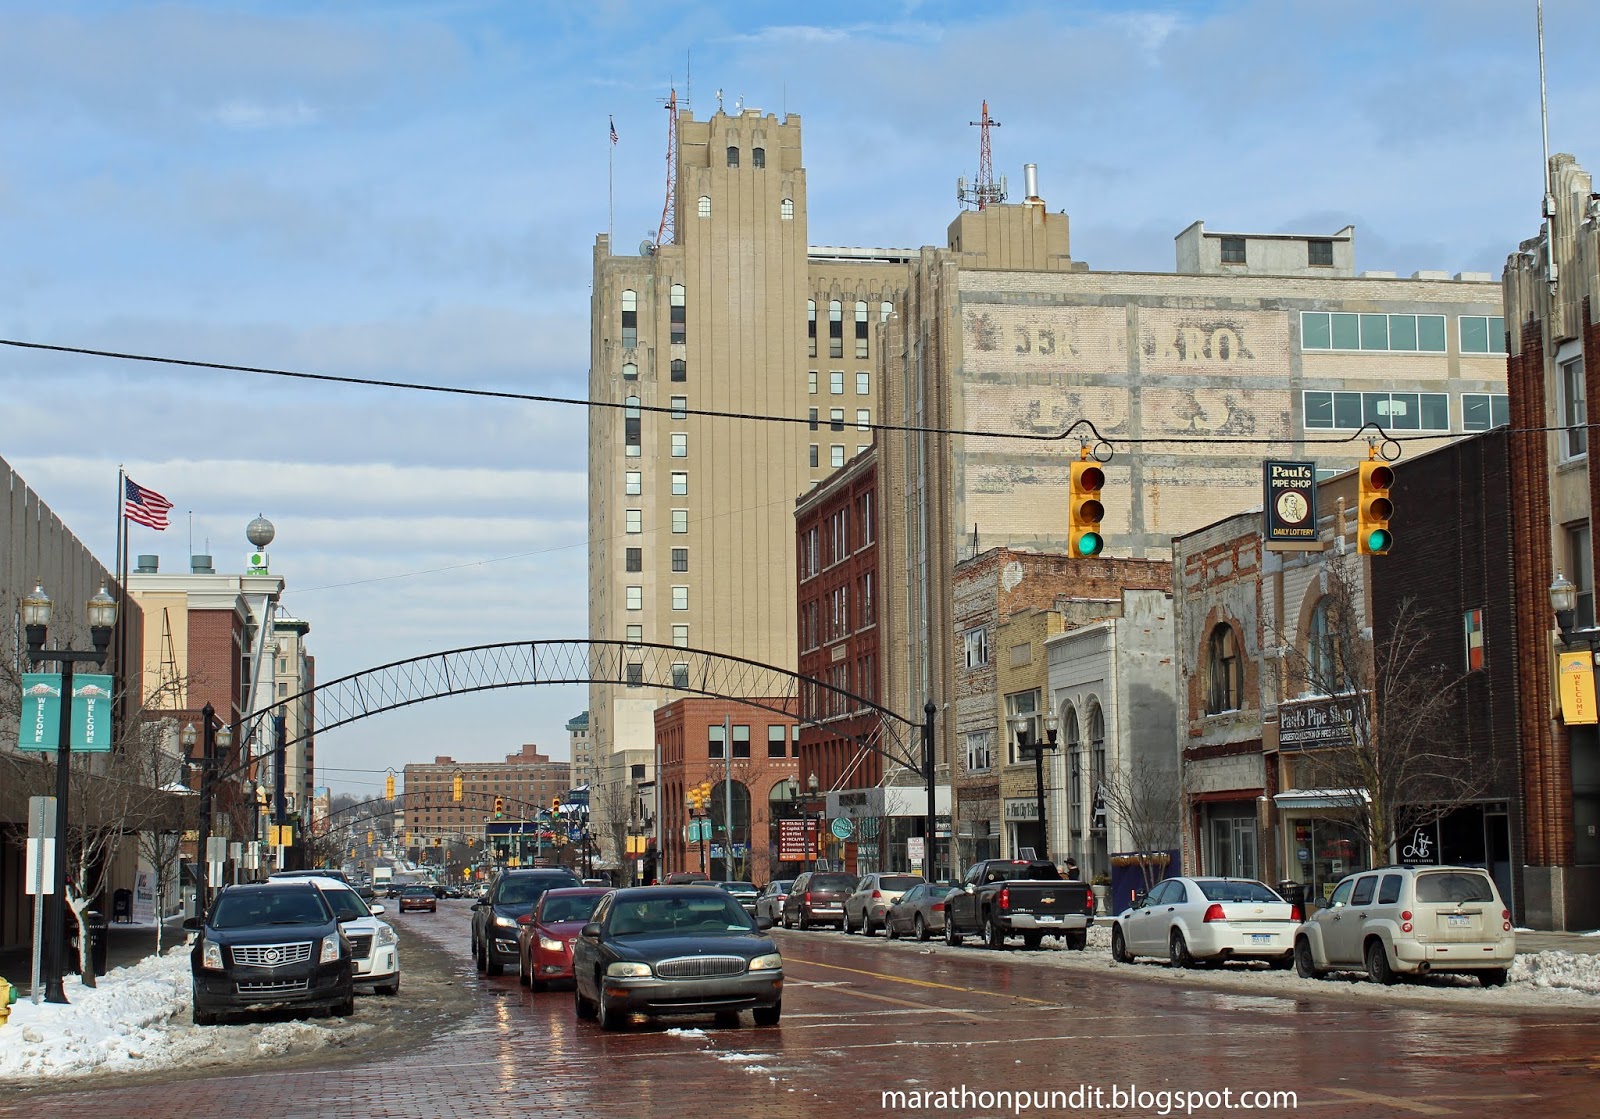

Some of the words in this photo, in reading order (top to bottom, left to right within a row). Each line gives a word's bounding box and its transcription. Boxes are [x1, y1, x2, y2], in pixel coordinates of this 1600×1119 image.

[1272, 466, 1311, 478] Paul's
[1272, 479, 1289, 488] PIPE
[1291, 479, 1311, 488] SHOP
[1273, 528, 1289, 536] DAILY
[1290, 528, 1314, 536] LOTTERY
[1573, 674, 1583, 716] WELCOME
[35, 697, 46, 742] WELCOME
[86, 698, 96, 744] WELCOME
[1281, 709, 1306, 728] Paul's
[1308, 707, 1327, 728] Pipe
